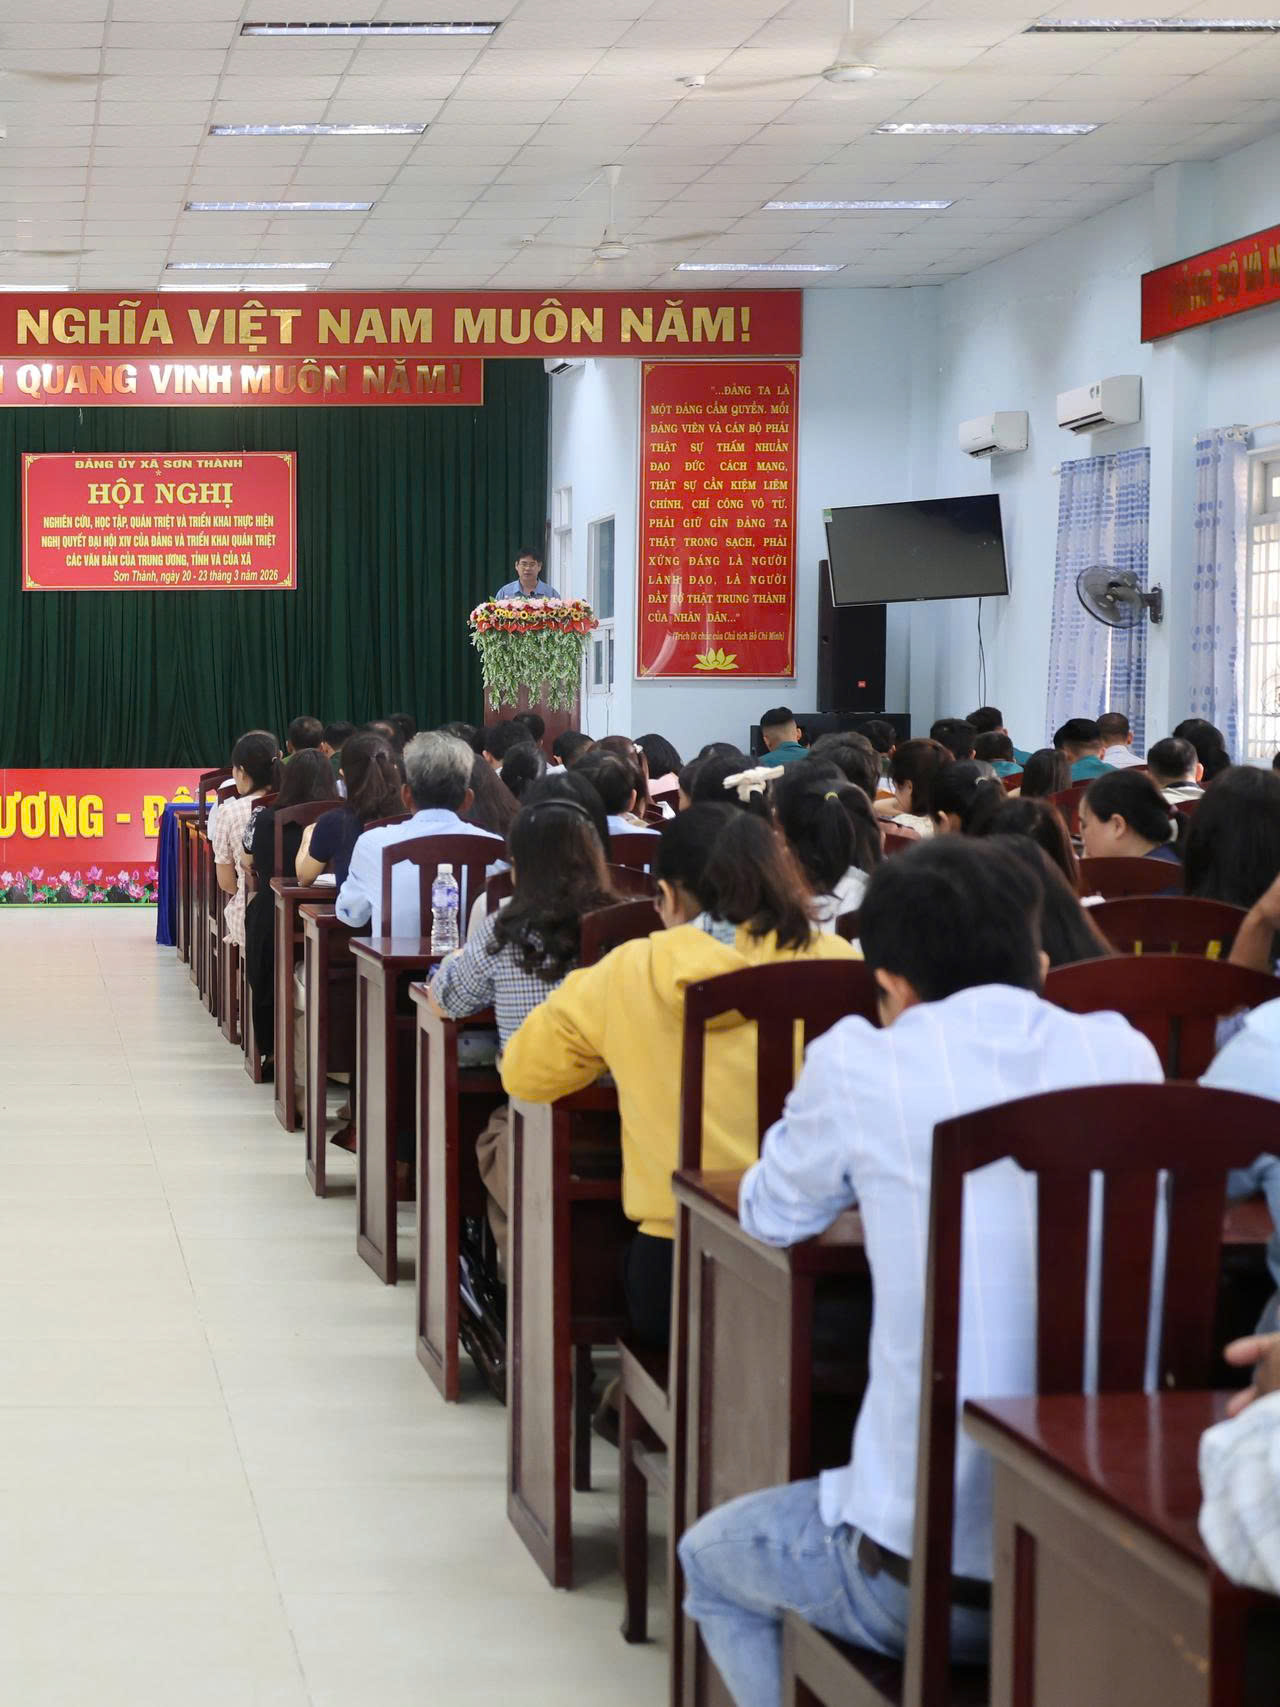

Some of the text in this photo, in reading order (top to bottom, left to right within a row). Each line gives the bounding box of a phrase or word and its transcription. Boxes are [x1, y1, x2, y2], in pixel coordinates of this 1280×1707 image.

[18, 301, 173, 344] NGHĨA
[189, 300, 301, 352] VIỆT
[319, 308, 433, 344] NAM
[455, 299, 604, 344] MUÔN
[619, 297, 750, 344] NĂM!
[16, 363, 138, 398] QUANG
[151, 364, 234, 395] VINH
[240, 358, 348, 394] MUÔN
[363, 358, 461, 394] NĂM!
[75, 458, 242, 468] ĐẢNG ỦY XÃ SƠN THÀNH
[88, 478, 233, 509] HỘI NGHỊ
[44, 515, 72, 528] NGHIÊN
[95, 516, 110, 531] HỌC
[130, 514, 152, 528] QUÁN
[154, 515, 174, 531] TRIỆT
[177, 514, 187, 527] VÀ
[189, 512, 211, 527] TRIỂN
[213, 516, 231, 527] KHAI
[234, 515, 253, 529] THỰC
[256, 513, 274, 529] HIỆN
[42, 531, 275, 550] NGHỊ QUYẾT ĐẠI HỘI XIV CỦA ĐẢNG VÀ TRIỂN KHAI QUÁN TRIỆT
[66, 553, 81, 566] CÁC
[84, 553, 100, 566] VĂN
[102, 552, 118, 566] BẢN
[120, 551, 136, 566] CỦA
[138, 555, 163, 566] TRUNG
[192, 551, 208, 565] TỈNH
[211, 552, 221, 565] VÀ
[223, 551, 238, 565] CỦA
[241, 552, 251, 565] XÃ
[113, 571, 129, 582] Sơn
[160, 571, 180, 584] ngày
[182, 571, 191, 581] 20
[198, 570, 207, 581] 23
[209, 570, 231, 583] tháng
[234, 570, 238, 581] 3
[241, 571, 257, 581] năm
[260, 570, 278, 580] 2026
